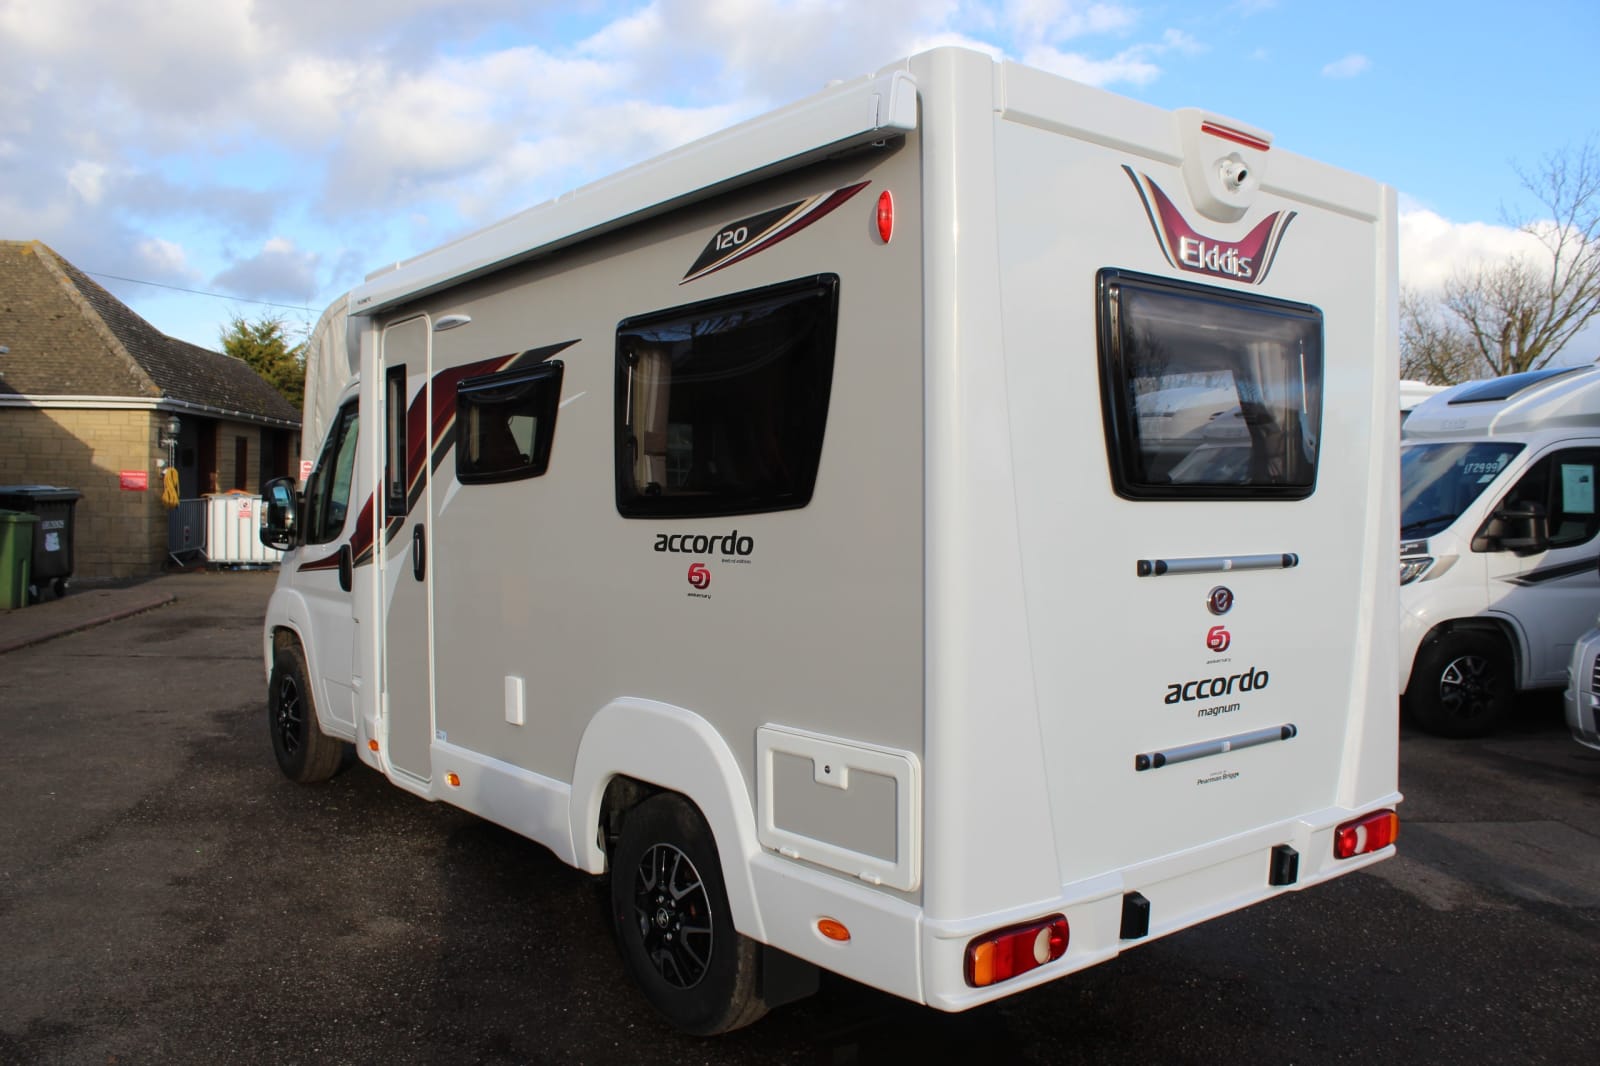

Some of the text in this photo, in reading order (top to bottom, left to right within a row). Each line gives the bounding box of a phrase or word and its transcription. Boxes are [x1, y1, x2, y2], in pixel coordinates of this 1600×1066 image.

[716, 226, 748, 250] 120
[1179, 235, 1253, 278] Elddis
[653, 529, 754, 556] accordo
[1164, 666, 1269, 705] accordo
[1197, 702, 1241, 718] magnum
